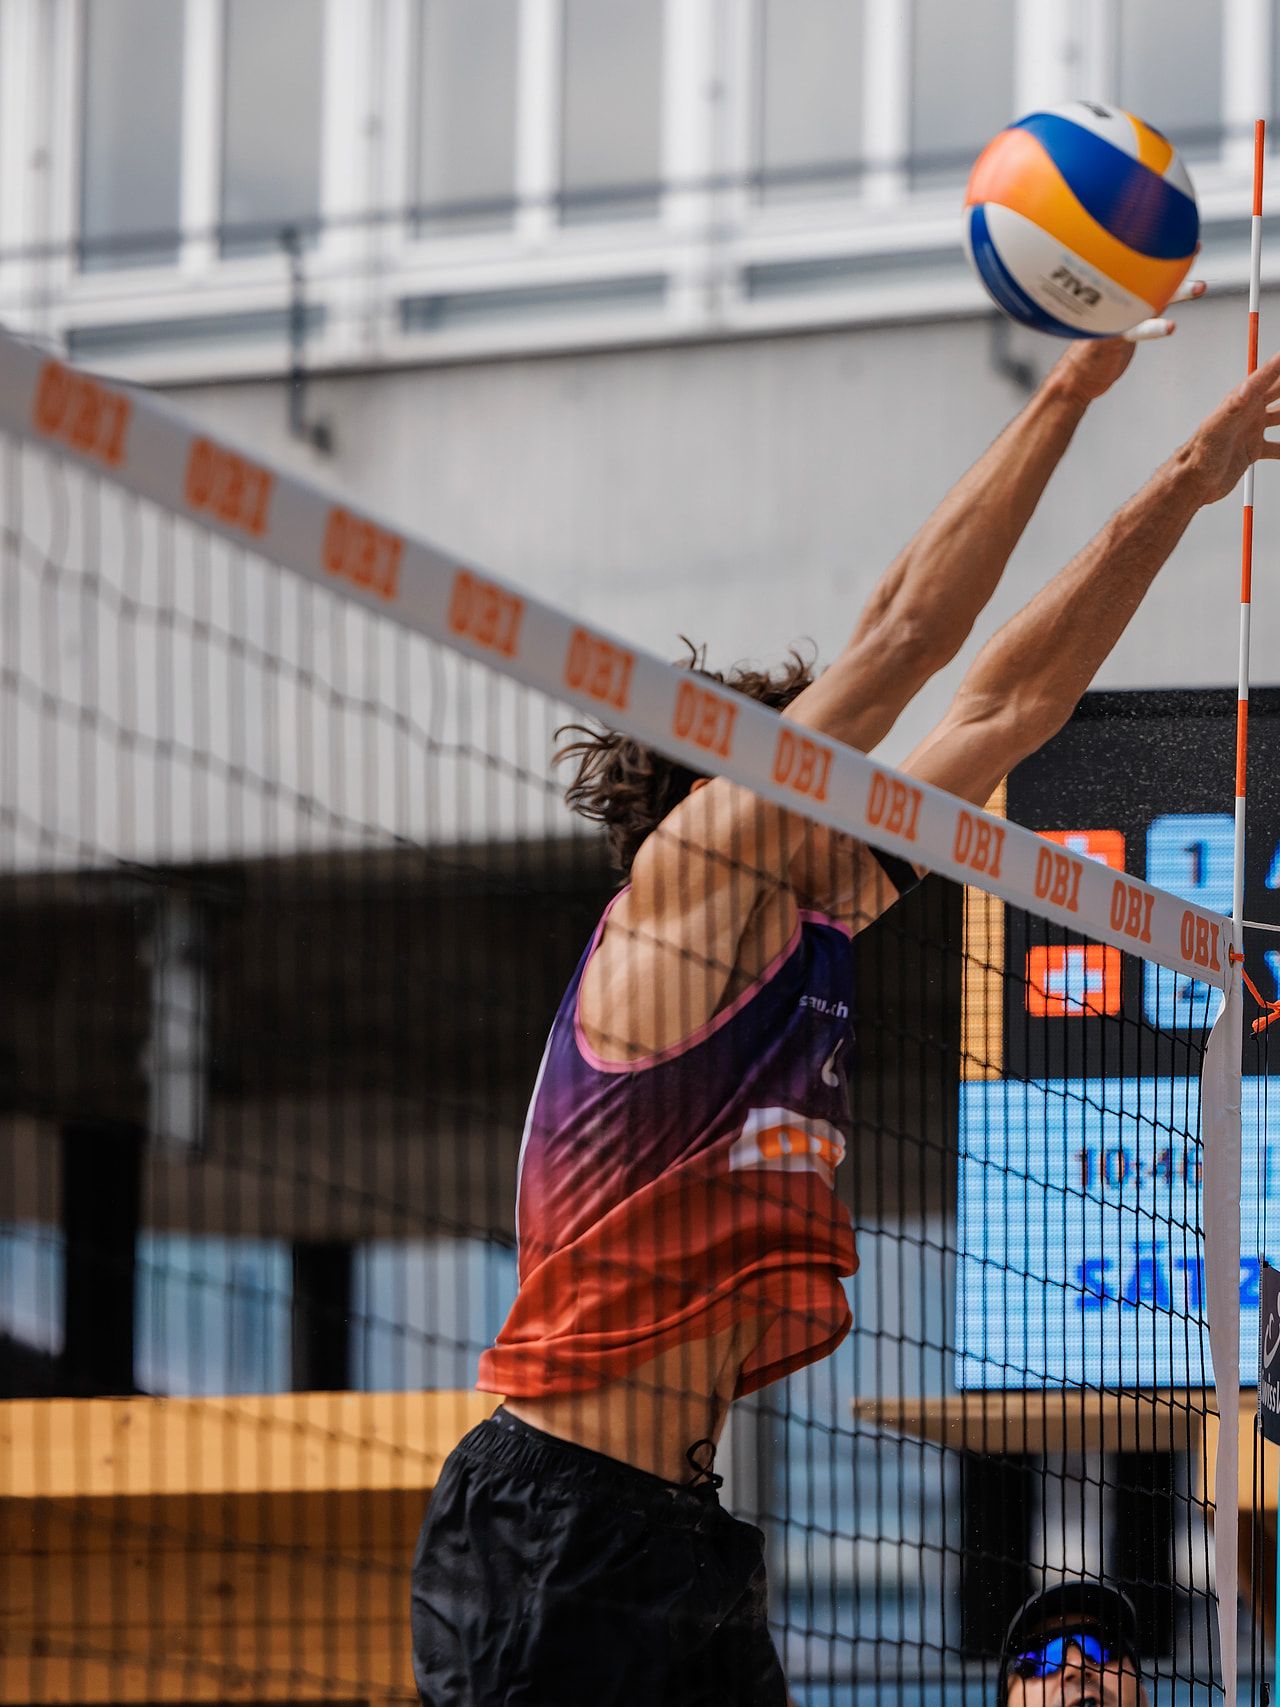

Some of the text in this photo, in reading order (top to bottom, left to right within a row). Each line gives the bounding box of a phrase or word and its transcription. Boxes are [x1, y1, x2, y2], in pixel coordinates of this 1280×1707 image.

[184, 436, 273, 539] OBI
[322, 506, 405, 600] OBI
[447, 571, 525, 660] OBI
[563, 628, 636, 711] OBI
[673, 680, 739, 760] OBI
[771, 728, 834, 803] OBI
[865, 771, 924, 842] OBI
[952, 810, 1006, 880] OBI
[1034, 846, 1083, 913] OBI
[1186, 838, 1208, 889] 1
[1110, 879, 1155, 944] OBI
[1180, 910, 1221, 972] OBI
